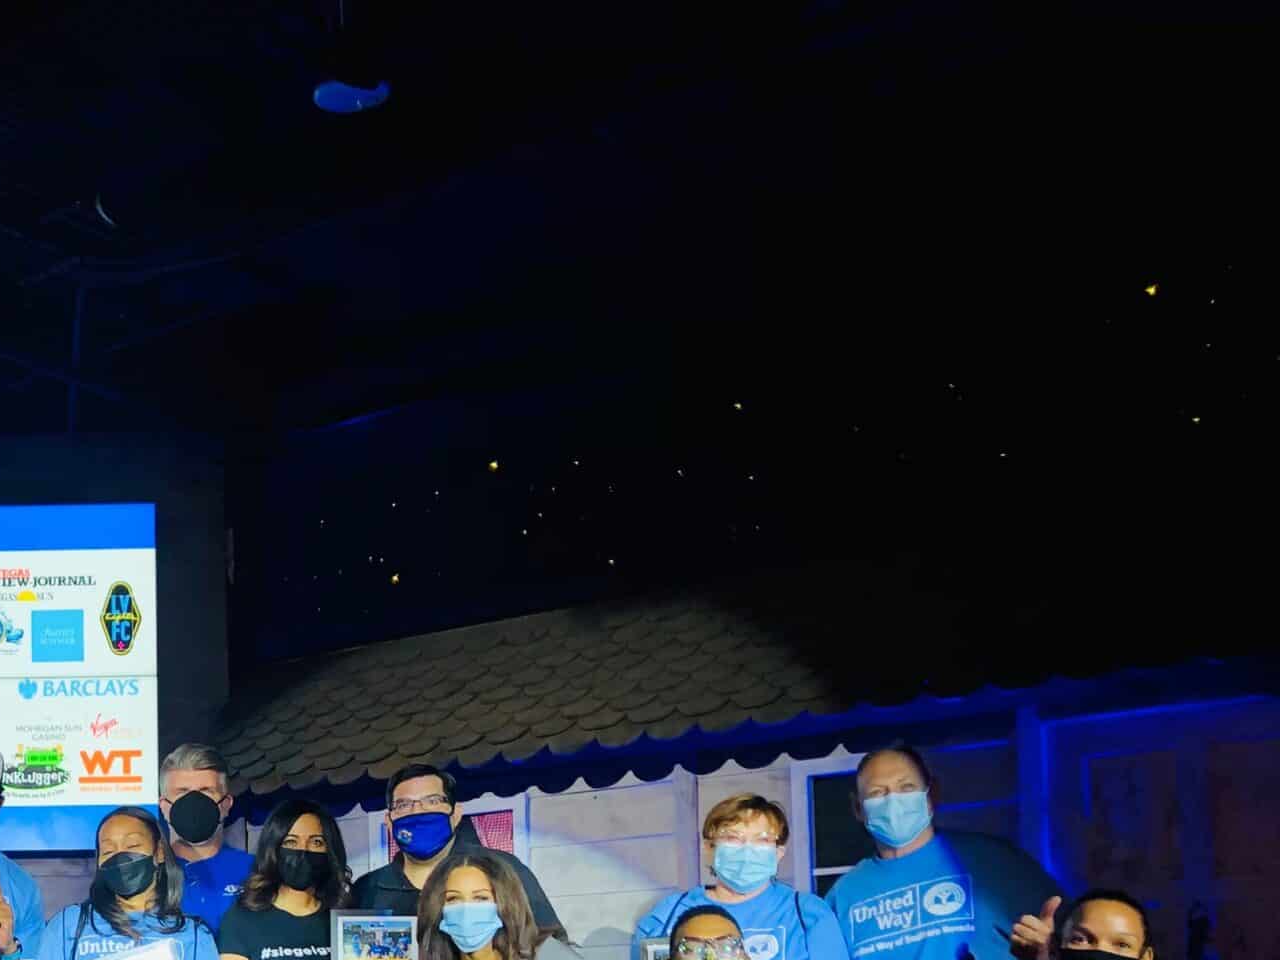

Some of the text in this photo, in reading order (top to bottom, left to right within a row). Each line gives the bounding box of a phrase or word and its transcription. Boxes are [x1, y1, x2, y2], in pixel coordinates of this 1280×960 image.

[111, 594, 132, 613] LV
[111, 622, 131, 641] FC
[43, 679, 139, 697] BARCLAYS
[79, 749, 143, 775] WT
[854, 889, 914, 923] United
[877, 909, 914, 931] Way
